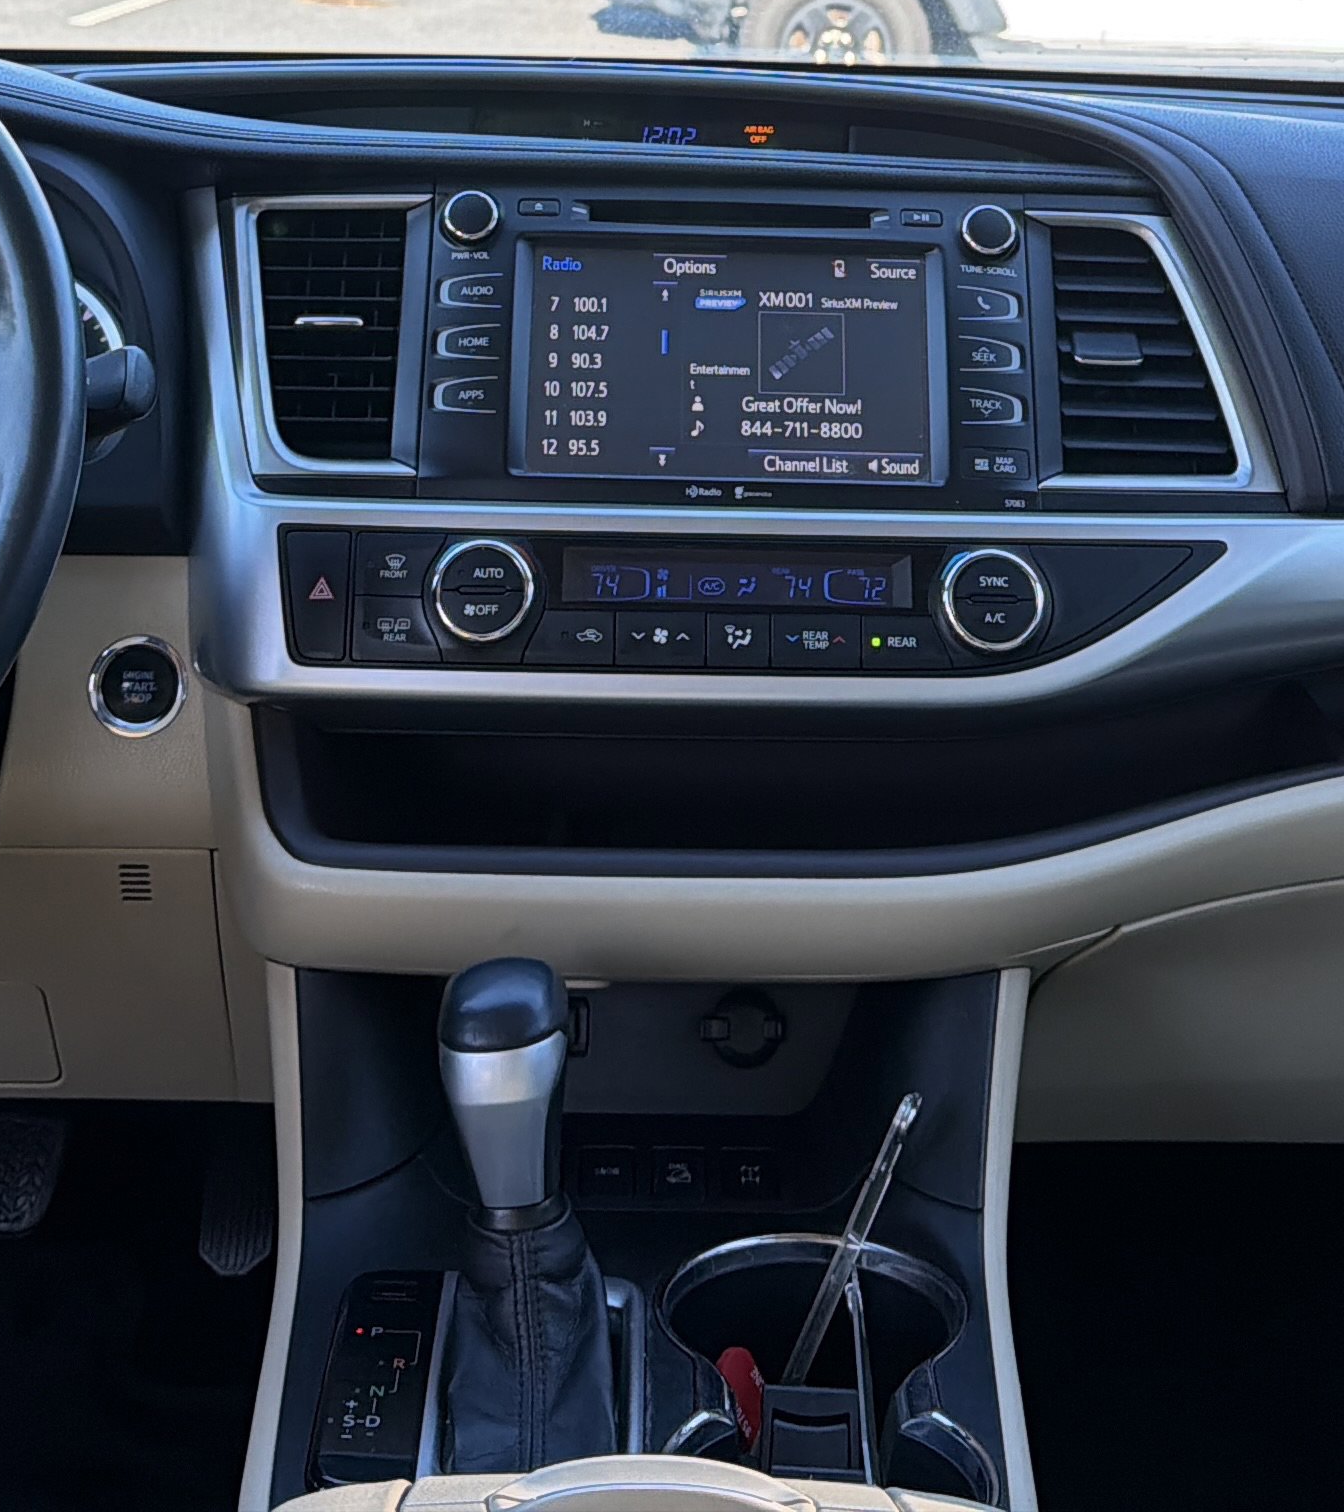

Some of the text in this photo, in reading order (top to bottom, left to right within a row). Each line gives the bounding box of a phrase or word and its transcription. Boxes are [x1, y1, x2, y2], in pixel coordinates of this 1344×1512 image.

[642, 126, 696, 144] 12:02
[744, 126, 774, 134] AIR BAG
[750, 135, 767, 144] OFF
[542, 256, 582, 272] Radio
[663, 258, 717, 276] Options
[870, 264, 917, 280] Source
[460, 285, 493, 296] AUDIO
[699, 289, 742, 297] SIRIUSXM
[550, 296, 607, 313] 7 100.1
[700, 299, 738, 307] PREVIEW
[821, 298, 861, 309] SiriusXM
[864, 298, 898, 310] Preview
[549, 324, 609, 340] 8 104.7
[458, 337, 490, 347] HOME
[548, 352, 602, 369] 9 90.3
[971, 352, 997, 363] SEEK
[689, 363, 751, 376] Entertainmen
[544, 381, 608, 397] 10 107.5
[458, 390, 485, 400] APPS
[741, 396, 862, 415] Great Offer Now!
[969, 399, 1002, 410] TRACK
[544, 410, 607, 426] 11 103.9
[740, 420, 862, 438] 844-711-8800
[542, 439, 600, 455] 12 95.5
[763, 455, 919, 475] Channel List Sound
[995, 457, 1014, 465] MAP
[993, 464, 1017, 473] CARD
[473, 567, 504, 579] AUTO
[591, 573, 619, 595] 74
[784, 576, 812, 598] 74
[858, 577, 886, 600] 72
[979, 576, 1009, 587] SYNC
[476, 605, 499, 616] OFF
[984, 613, 1006, 624] A/C
[383, 634, 406, 642] REAR
[802, 631, 829, 640] REAR
[803, 640, 830, 650] TEMP
[887, 637, 917, 647] REAR
[371, 1326, 384, 1337] P
[393, 1358, 406, 1369] R
[369, 1385, 384, 1397] N
[342, 1414, 381, 1428] S D
